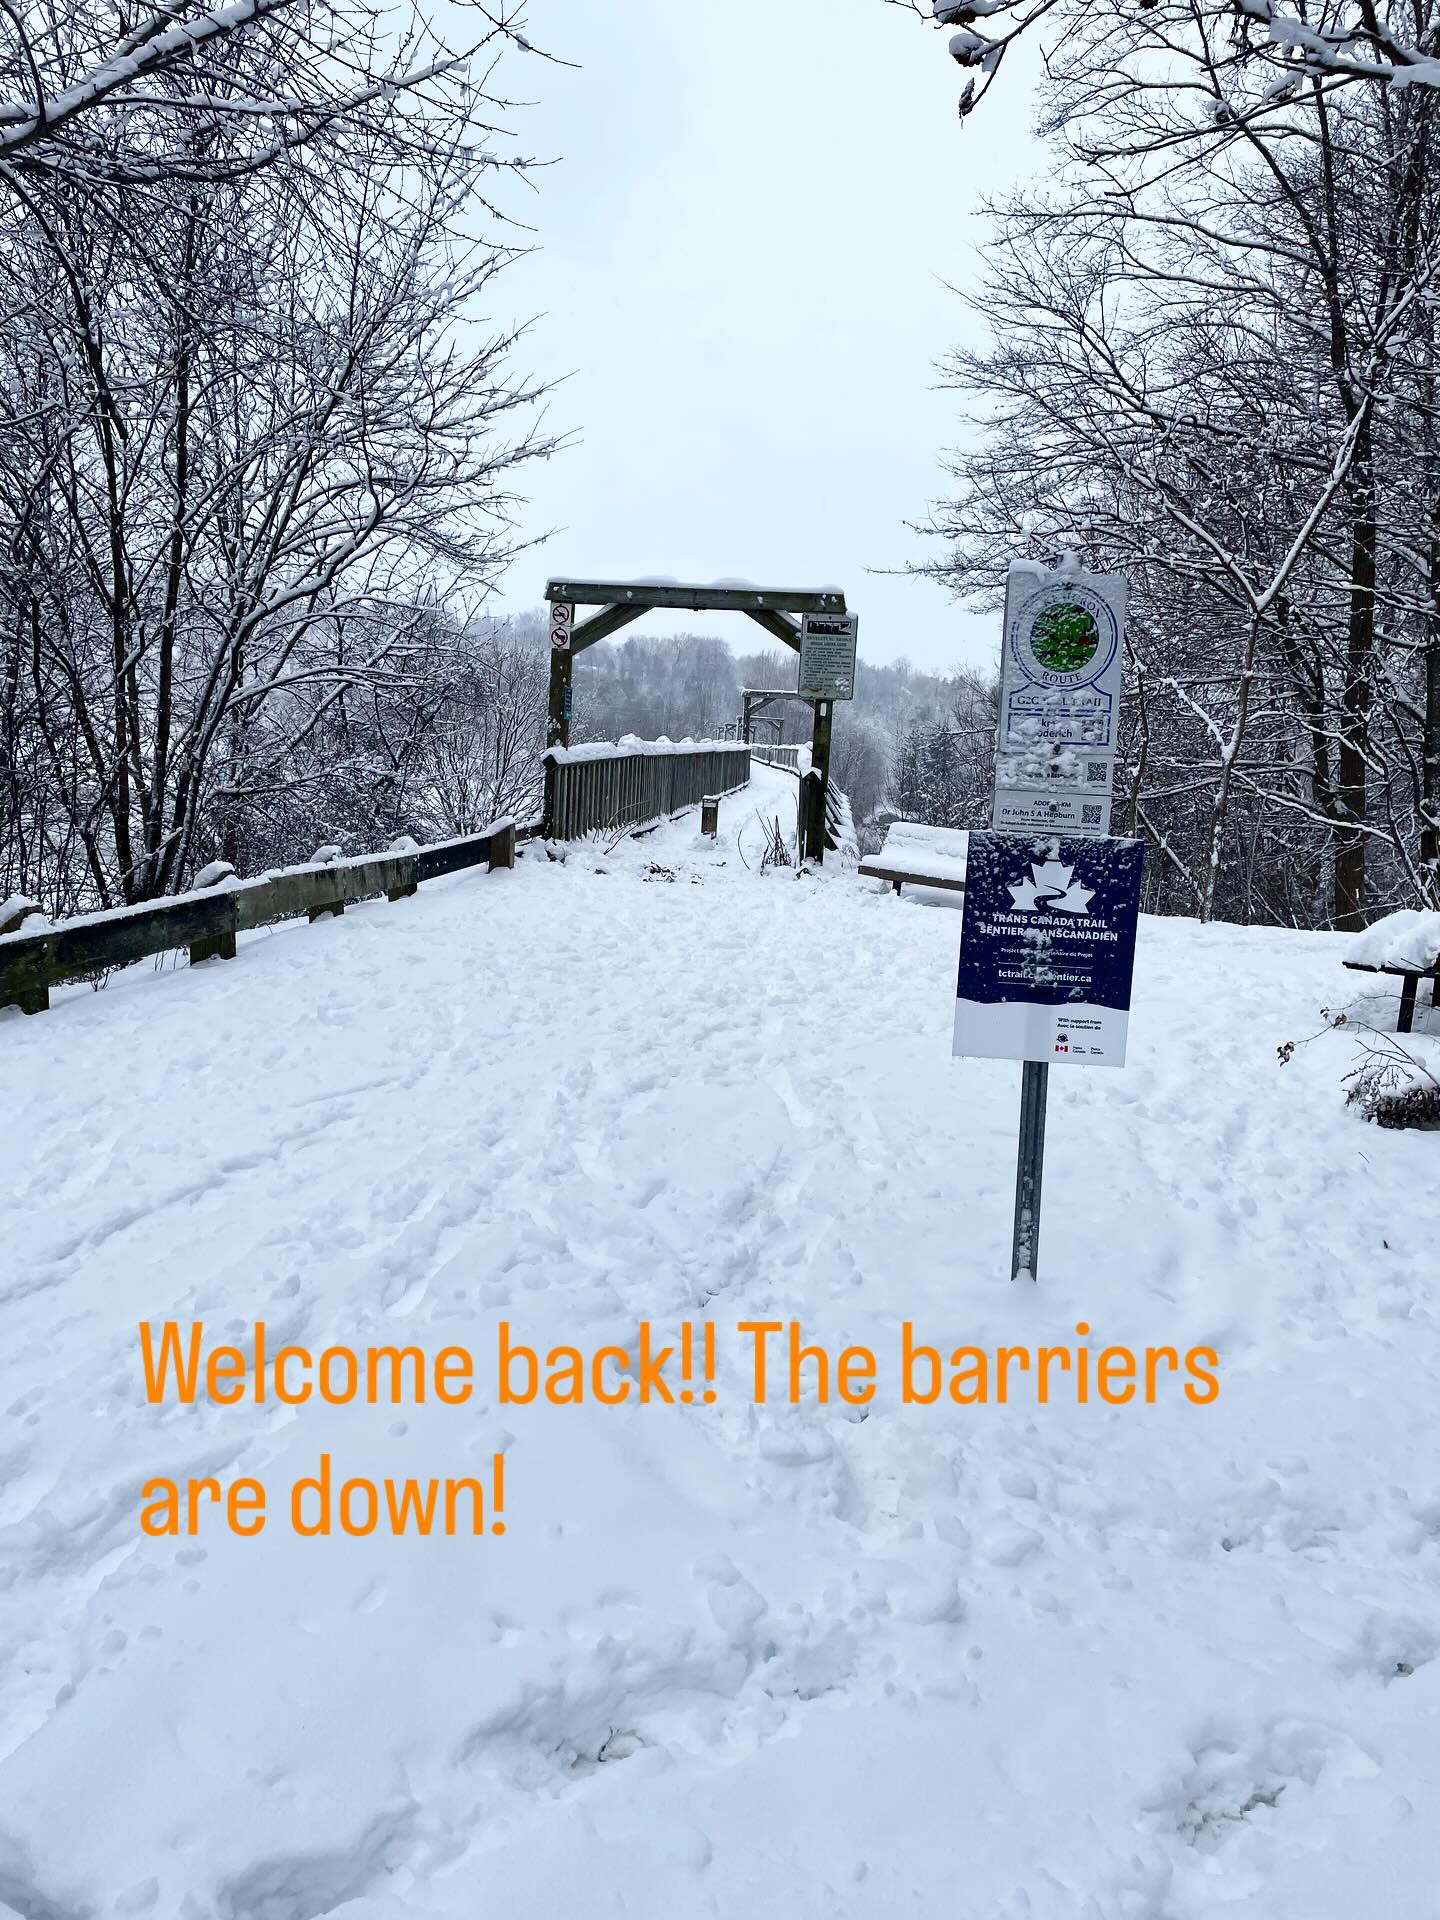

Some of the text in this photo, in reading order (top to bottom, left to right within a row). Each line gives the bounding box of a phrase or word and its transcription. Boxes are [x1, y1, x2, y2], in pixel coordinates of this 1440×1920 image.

[1041, 671, 1083, 685] ROUTE
[1037, 728, 1073, 738] oderich
[1001, 808, 1011, 816] Dr
[1012, 808, 1030, 817] John
[1036, 810, 1043, 818] A
[1044, 810, 1076, 820] Hepburn
[992, 913, 1108, 928] TRANS CANADA TRAIL
[979, 926, 1118, 941] SENTIER ANSCANADIEN
[998, 969, 1037, 979] tctrail.c
